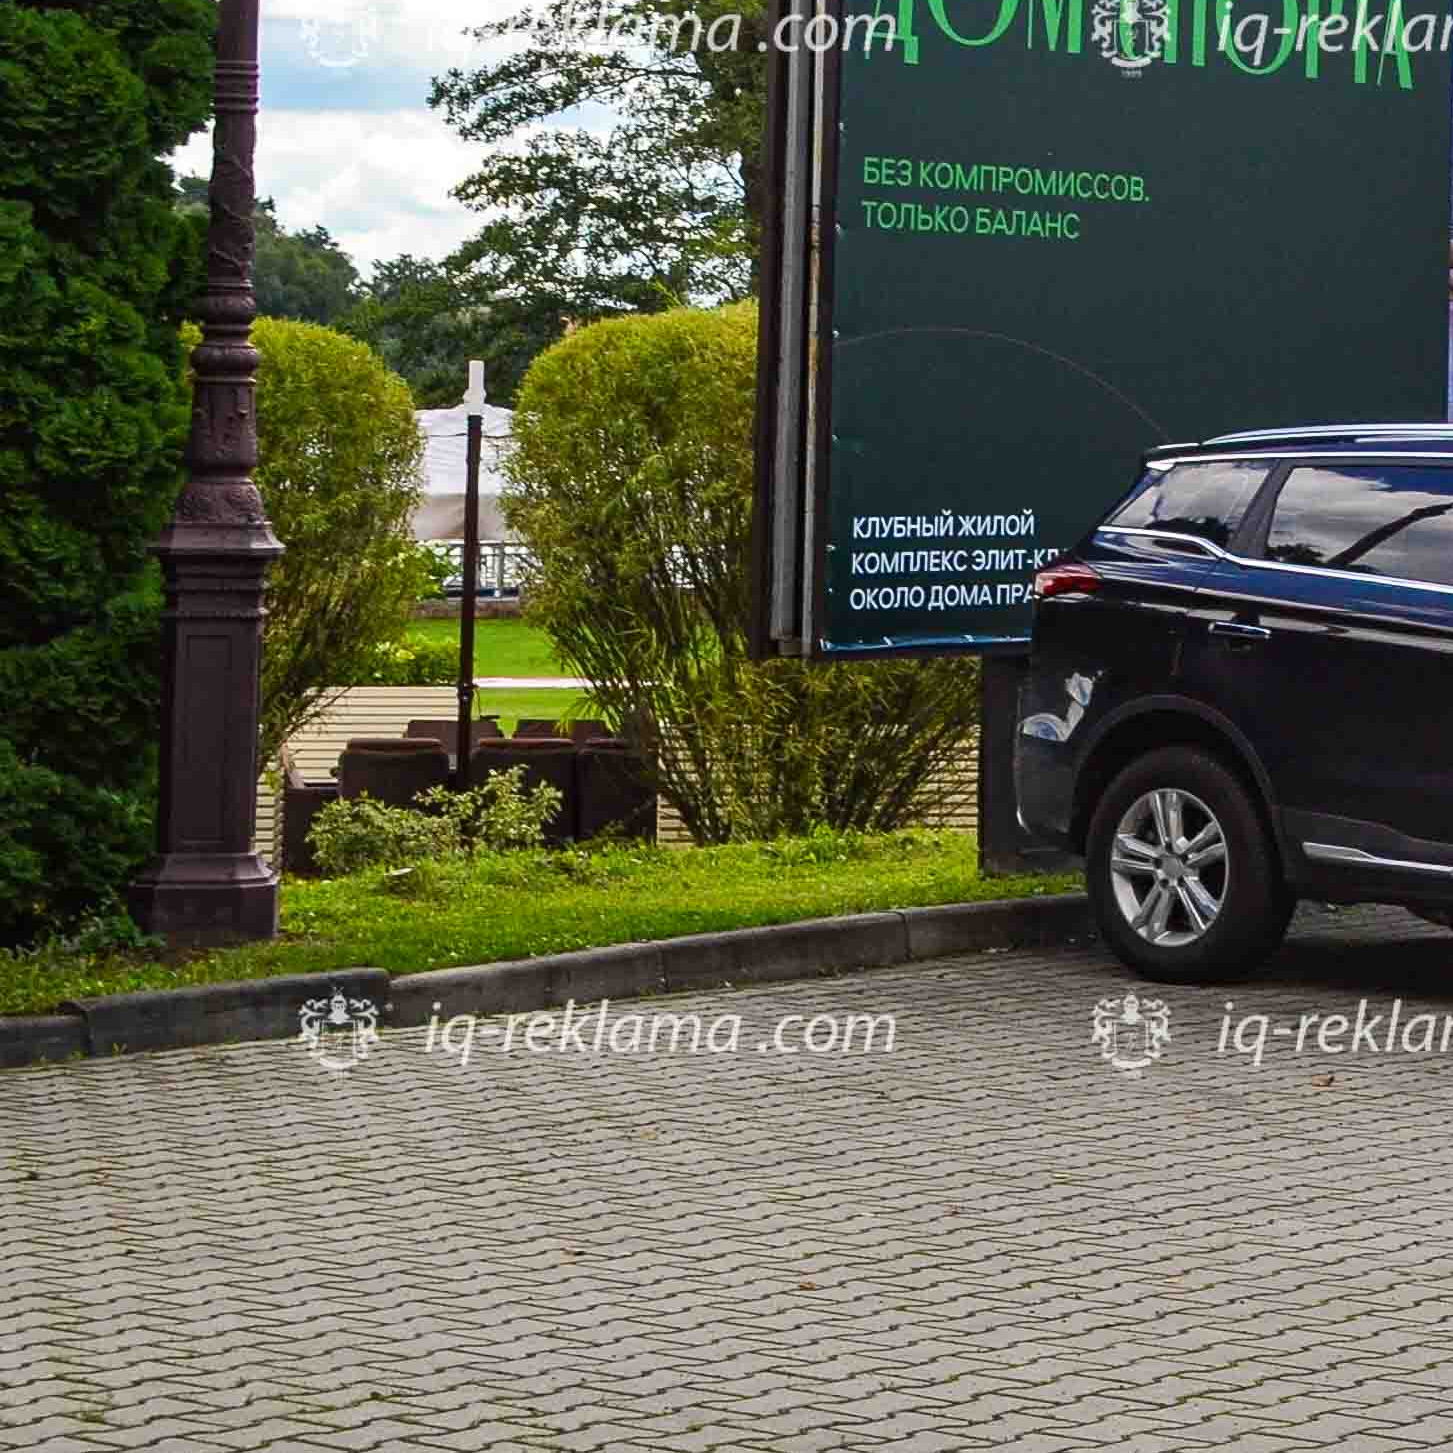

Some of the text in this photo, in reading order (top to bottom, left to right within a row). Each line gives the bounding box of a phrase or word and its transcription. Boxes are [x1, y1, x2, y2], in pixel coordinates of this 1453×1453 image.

[863, 156, 1151, 203] БЕЗ КОМПРОМИССОВ.
[860, 199, 1082, 240] ТОЛЬКО БАЛАНС
[852, 507, 1036, 539] КЛУБНЫЙ ЖИЛОЙ
[851, 548, 1060, 575] КОМПЛЕКС ЭЛИТ-К
[849, 586, 926, 611] ОКОЛО
[927, 585, 993, 612] ДОМА
